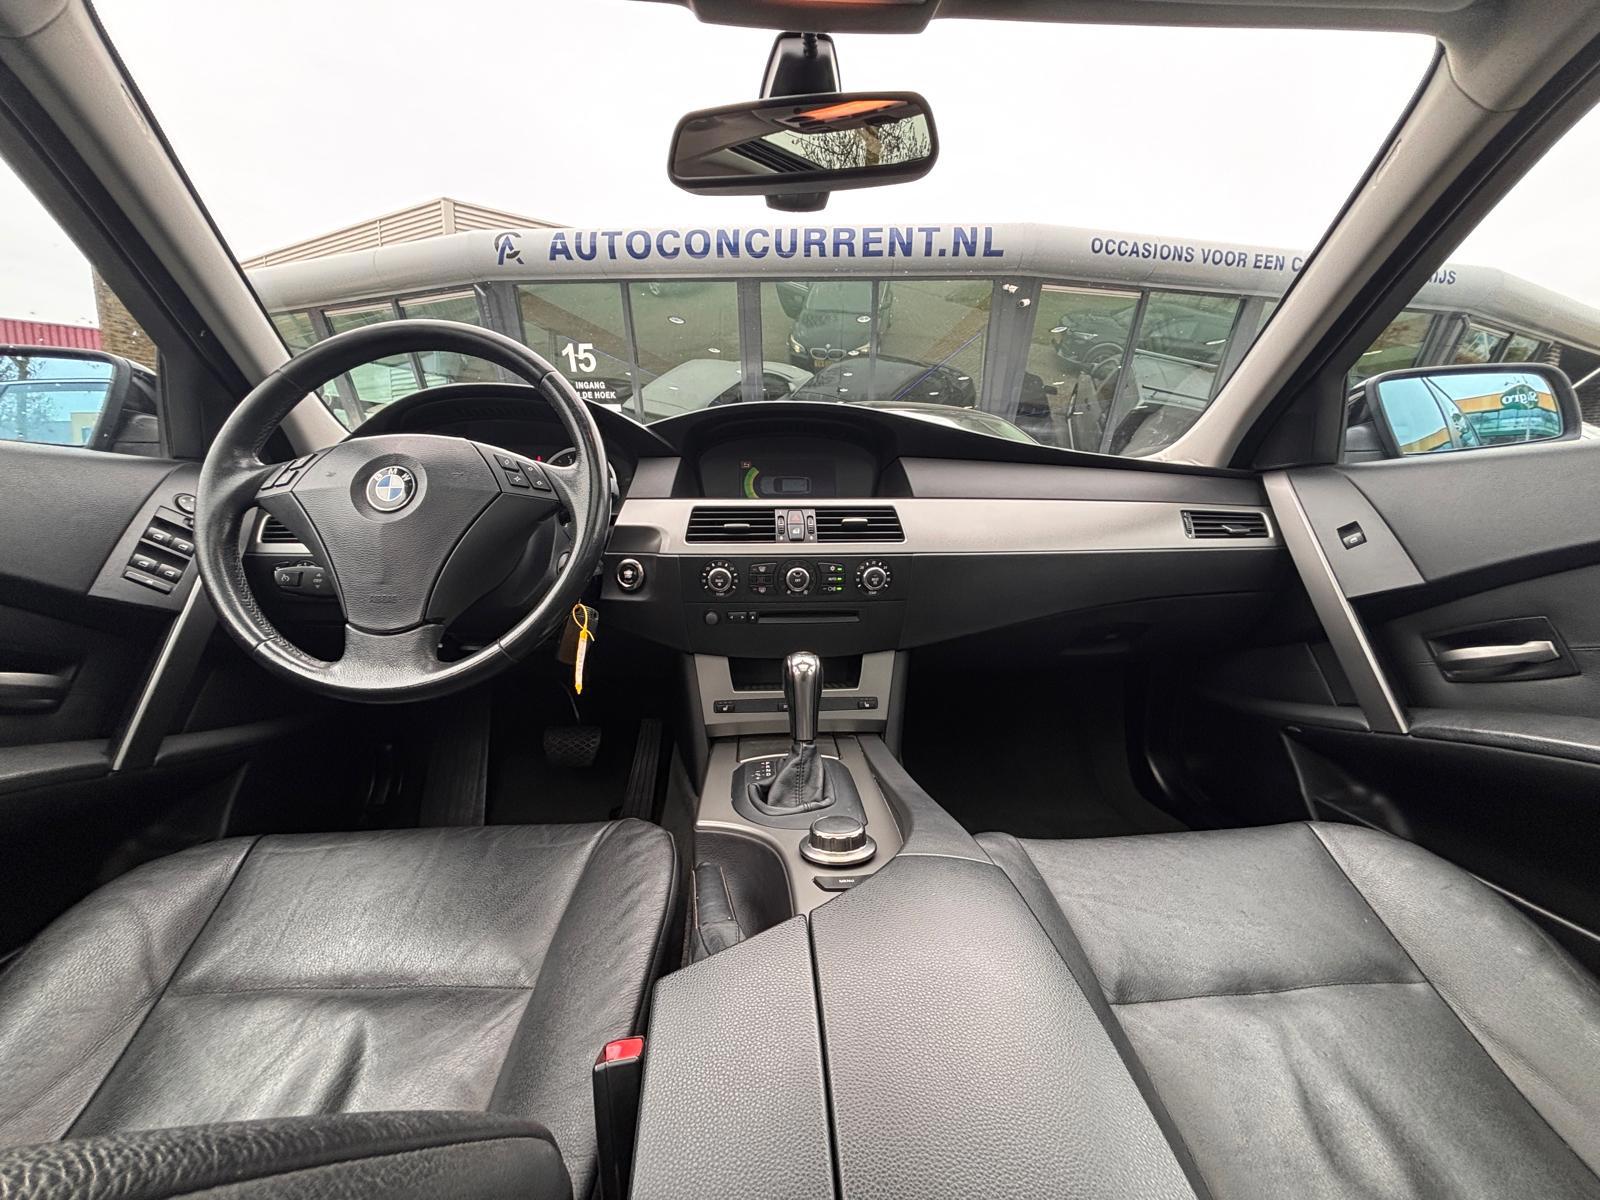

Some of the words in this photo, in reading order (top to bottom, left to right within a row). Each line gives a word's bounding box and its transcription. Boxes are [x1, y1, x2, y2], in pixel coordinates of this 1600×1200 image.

[549, 227, 1004, 261] AUTOCONCURRENT.NL
[1091, 238, 1195, 263] OCCASIONS
[1201, 248, 1248, 268] VOOR
[1253, 253, 1285, 271] EEN
[1428, 270, 1456, 285] IJS
[561, 343, 597, 373] 15
[575, 381, 606, 390] INGANG
[582, 391, 593, 399] DE
[594, 391, 616, 399] HOEK
[374, 468, 411, 481] BMW
